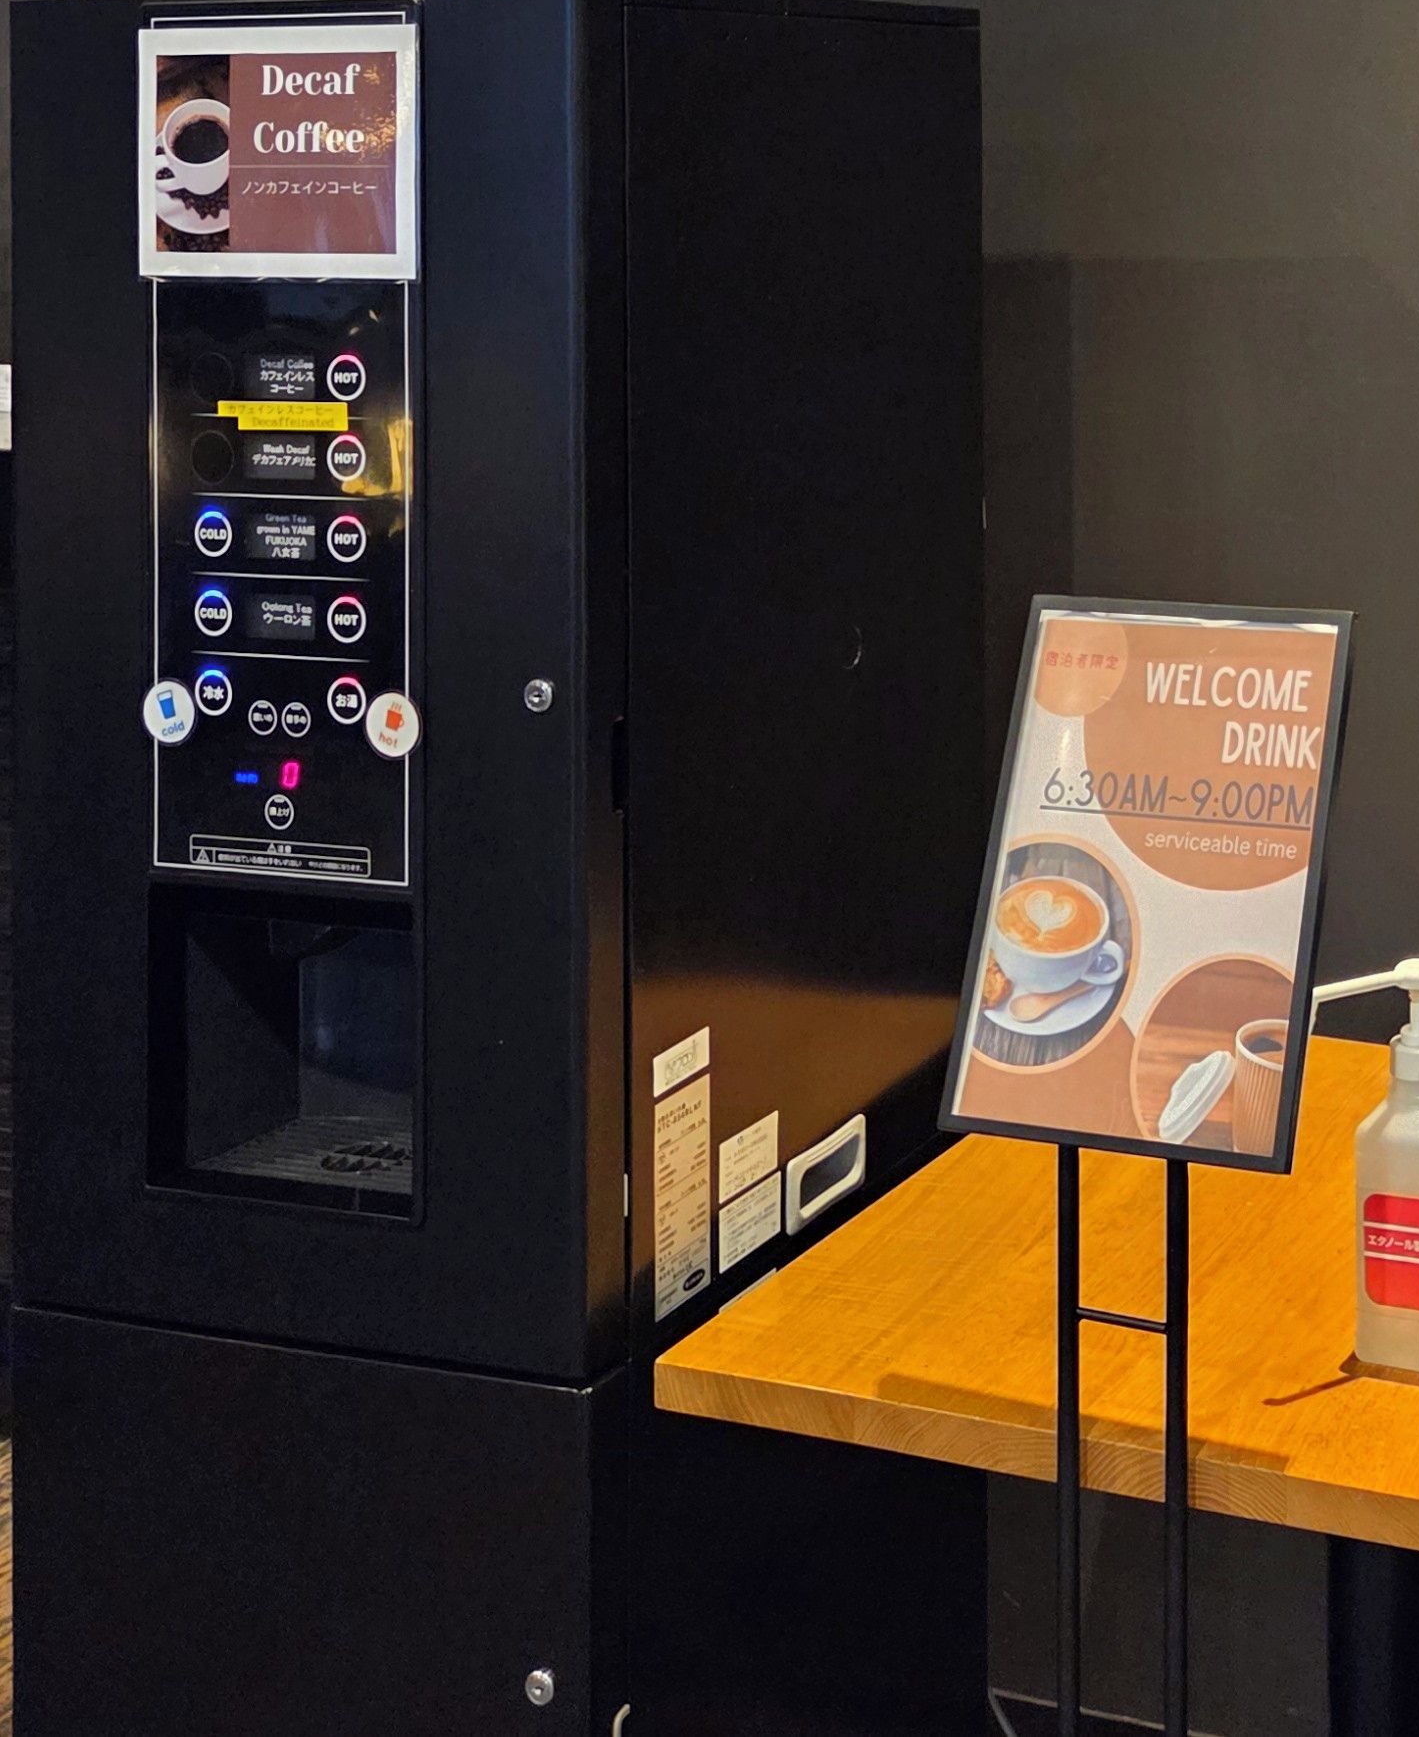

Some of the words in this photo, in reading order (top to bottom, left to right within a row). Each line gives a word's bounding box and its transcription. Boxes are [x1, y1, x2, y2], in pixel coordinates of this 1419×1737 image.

[261, 62, 361, 97] Decaf
[253, 120, 366, 155] Coffee
[241, 179, 378, 197] ノンカフェインコーヒー
[260, 370, 315, 382] カフェインレス
[333, 372, 359, 384] HOT
[270, 383, 304, 394] コーヒー
[333, 452, 359, 464] HOT
[199, 528, 228, 541] COLD
[333, 533, 359, 545] HOT
[199, 607, 228, 620] COLD
[333, 614, 359, 626] HOT
[1144, 660, 1313, 714] WELCOME
[161, 721, 185, 737] cold
[378, 731, 398, 748] hot
[1221, 720, 1322, 771] DRINK
[1144, 829, 1252, 856] serviceable
[1254, 836, 1298, 860] time
